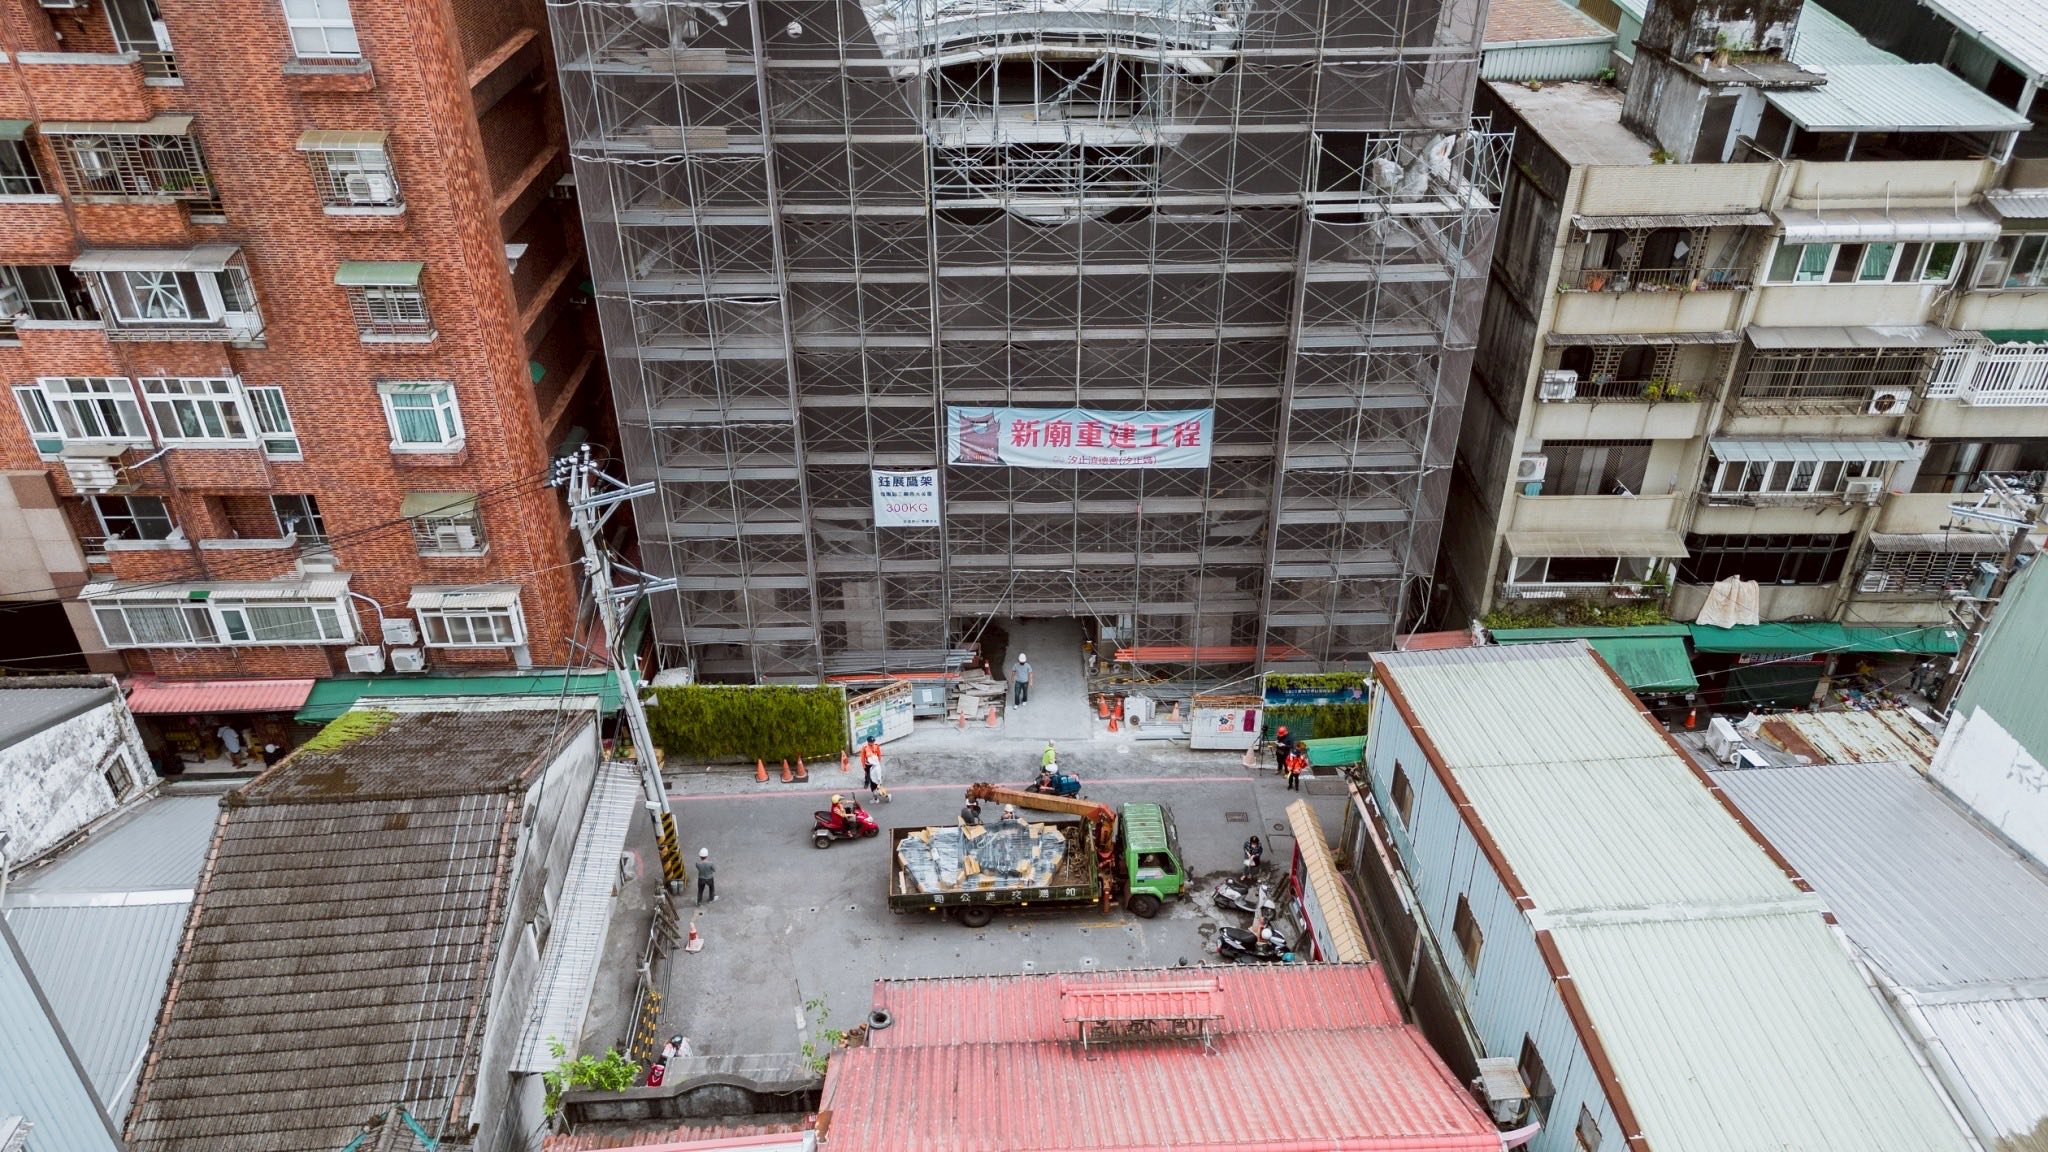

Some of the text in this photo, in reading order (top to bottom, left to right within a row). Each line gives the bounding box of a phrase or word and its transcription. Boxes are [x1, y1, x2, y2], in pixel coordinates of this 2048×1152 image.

[1010, 418, 1202, 449] 新廟重建工程
[886, 503, 928, 513] 300KG
